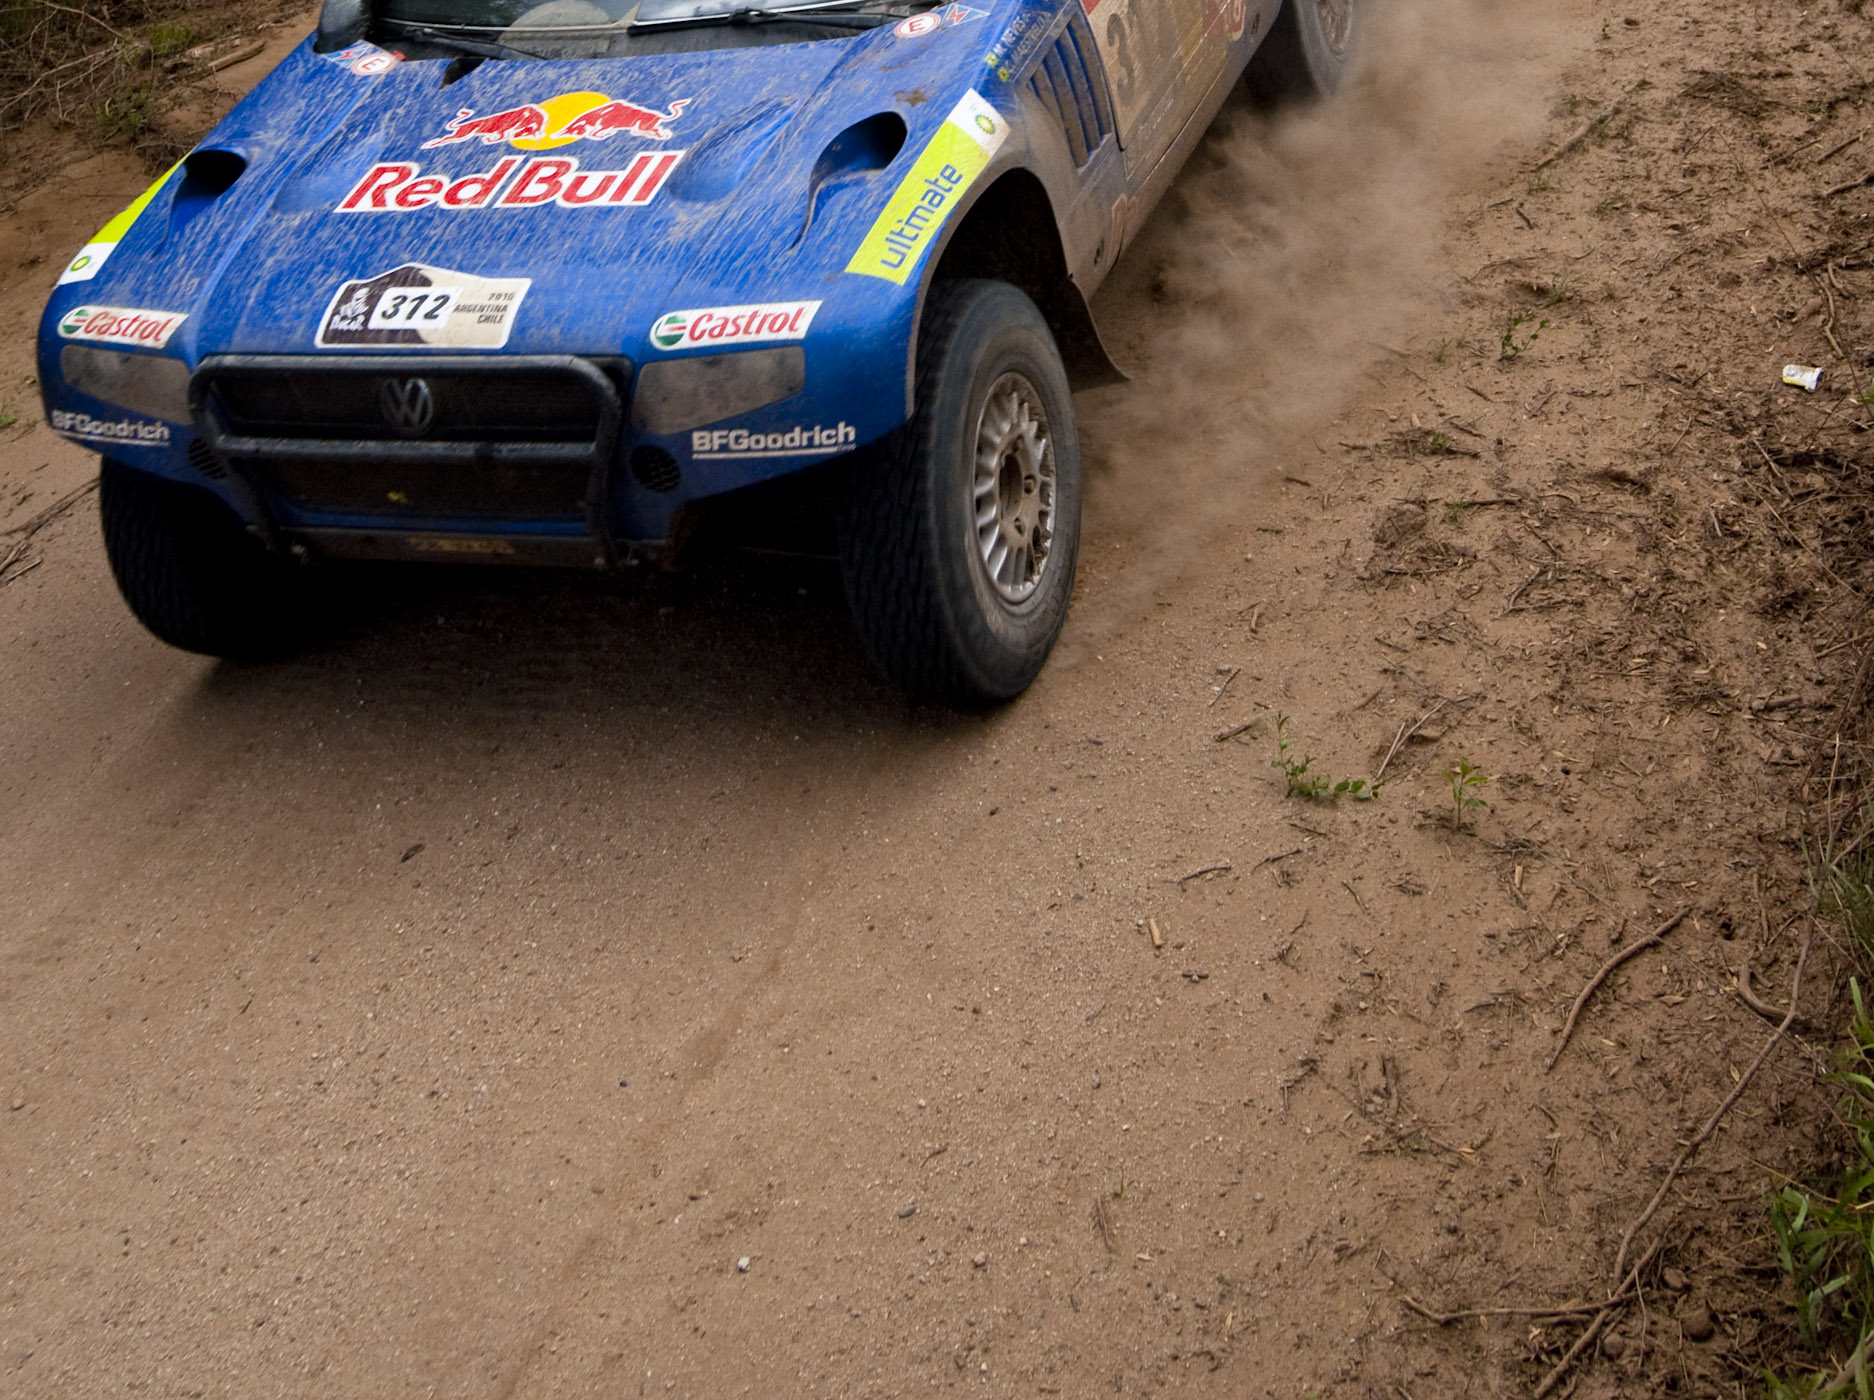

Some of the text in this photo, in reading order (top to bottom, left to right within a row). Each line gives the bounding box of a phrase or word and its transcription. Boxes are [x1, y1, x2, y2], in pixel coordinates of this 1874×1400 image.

[336, 151, 684, 211] Red Bull
[881, 162, 963, 271] ultimate
[381, 294, 450, 321] 312
[453, 303, 509, 314] ARGENTINA
[488, 292, 516, 301] 2010
[84, 310, 175, 343] Castrol
[476, 314, 504, 325] CHILE
[689, 305, 806, 342] Castrol
[51, 409, 170, 440] BFGoodrich
[691, 421, 857, 451] BFGoodrich
